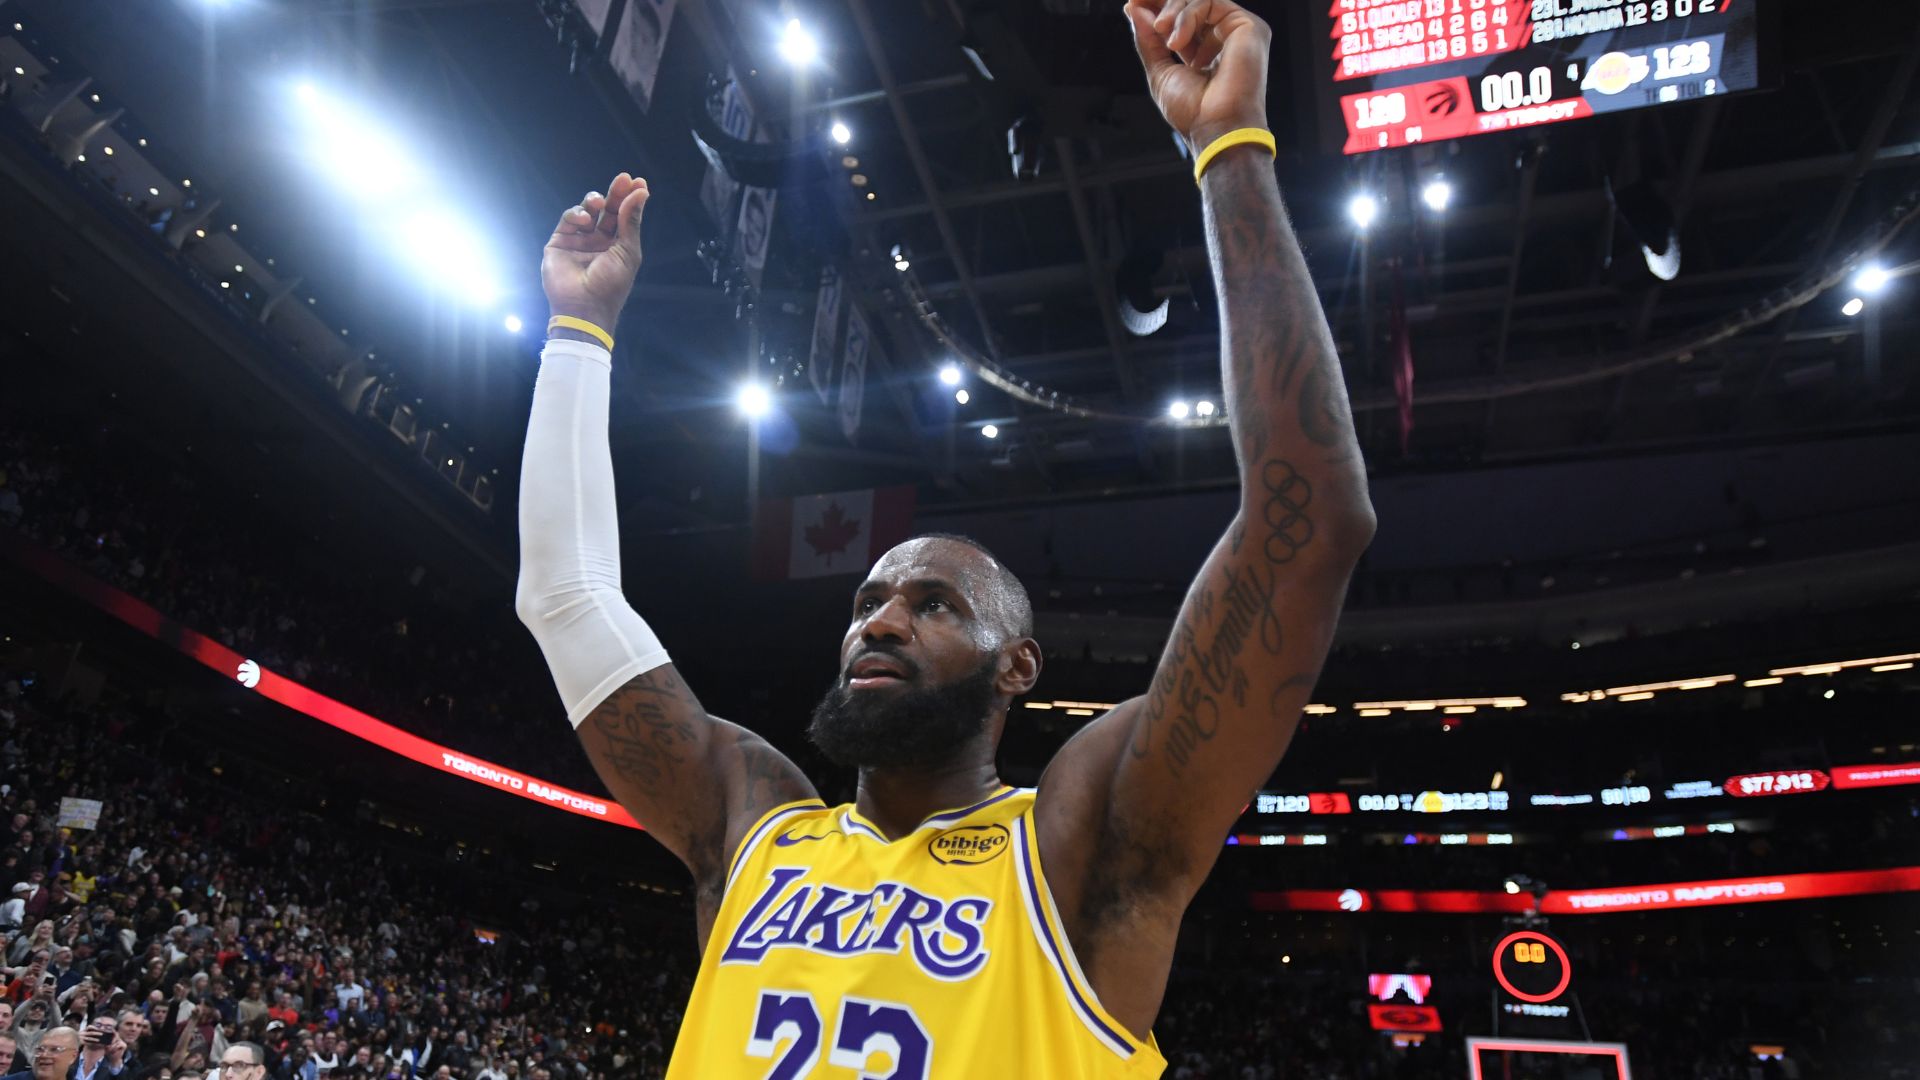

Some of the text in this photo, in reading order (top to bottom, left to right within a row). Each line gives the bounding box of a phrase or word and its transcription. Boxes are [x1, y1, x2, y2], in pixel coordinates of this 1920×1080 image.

[1427, 18, 1444, 38] 4
[1450, 14, 1465, 35] 2
[1470, 10, 1487, 31] 6
[1491, 6, 1508, 26] 4
[1625, 3, 1647, 27] 12
[1651, 0, 1668, 21] 3
[1675, 0, 1692, 17] 0
[1450, 35, 1467, 57] 8
[1495, 28, 1508, 50] 1
[1480, 66, 1552, 112] 00.0
[442, 753, 607, 815] TORONTO RAPTORS
[1739, 773, 1814, 794] $77,912
[1276, 795, 1310, 812] 120
[937, 835, 1006, 853] bibigo
[1568, 882, 1786, 908] TORONTO RAPTORS
[719, 866, 997, 983] LAKERS
[745, 988, 934, 1080] 23
